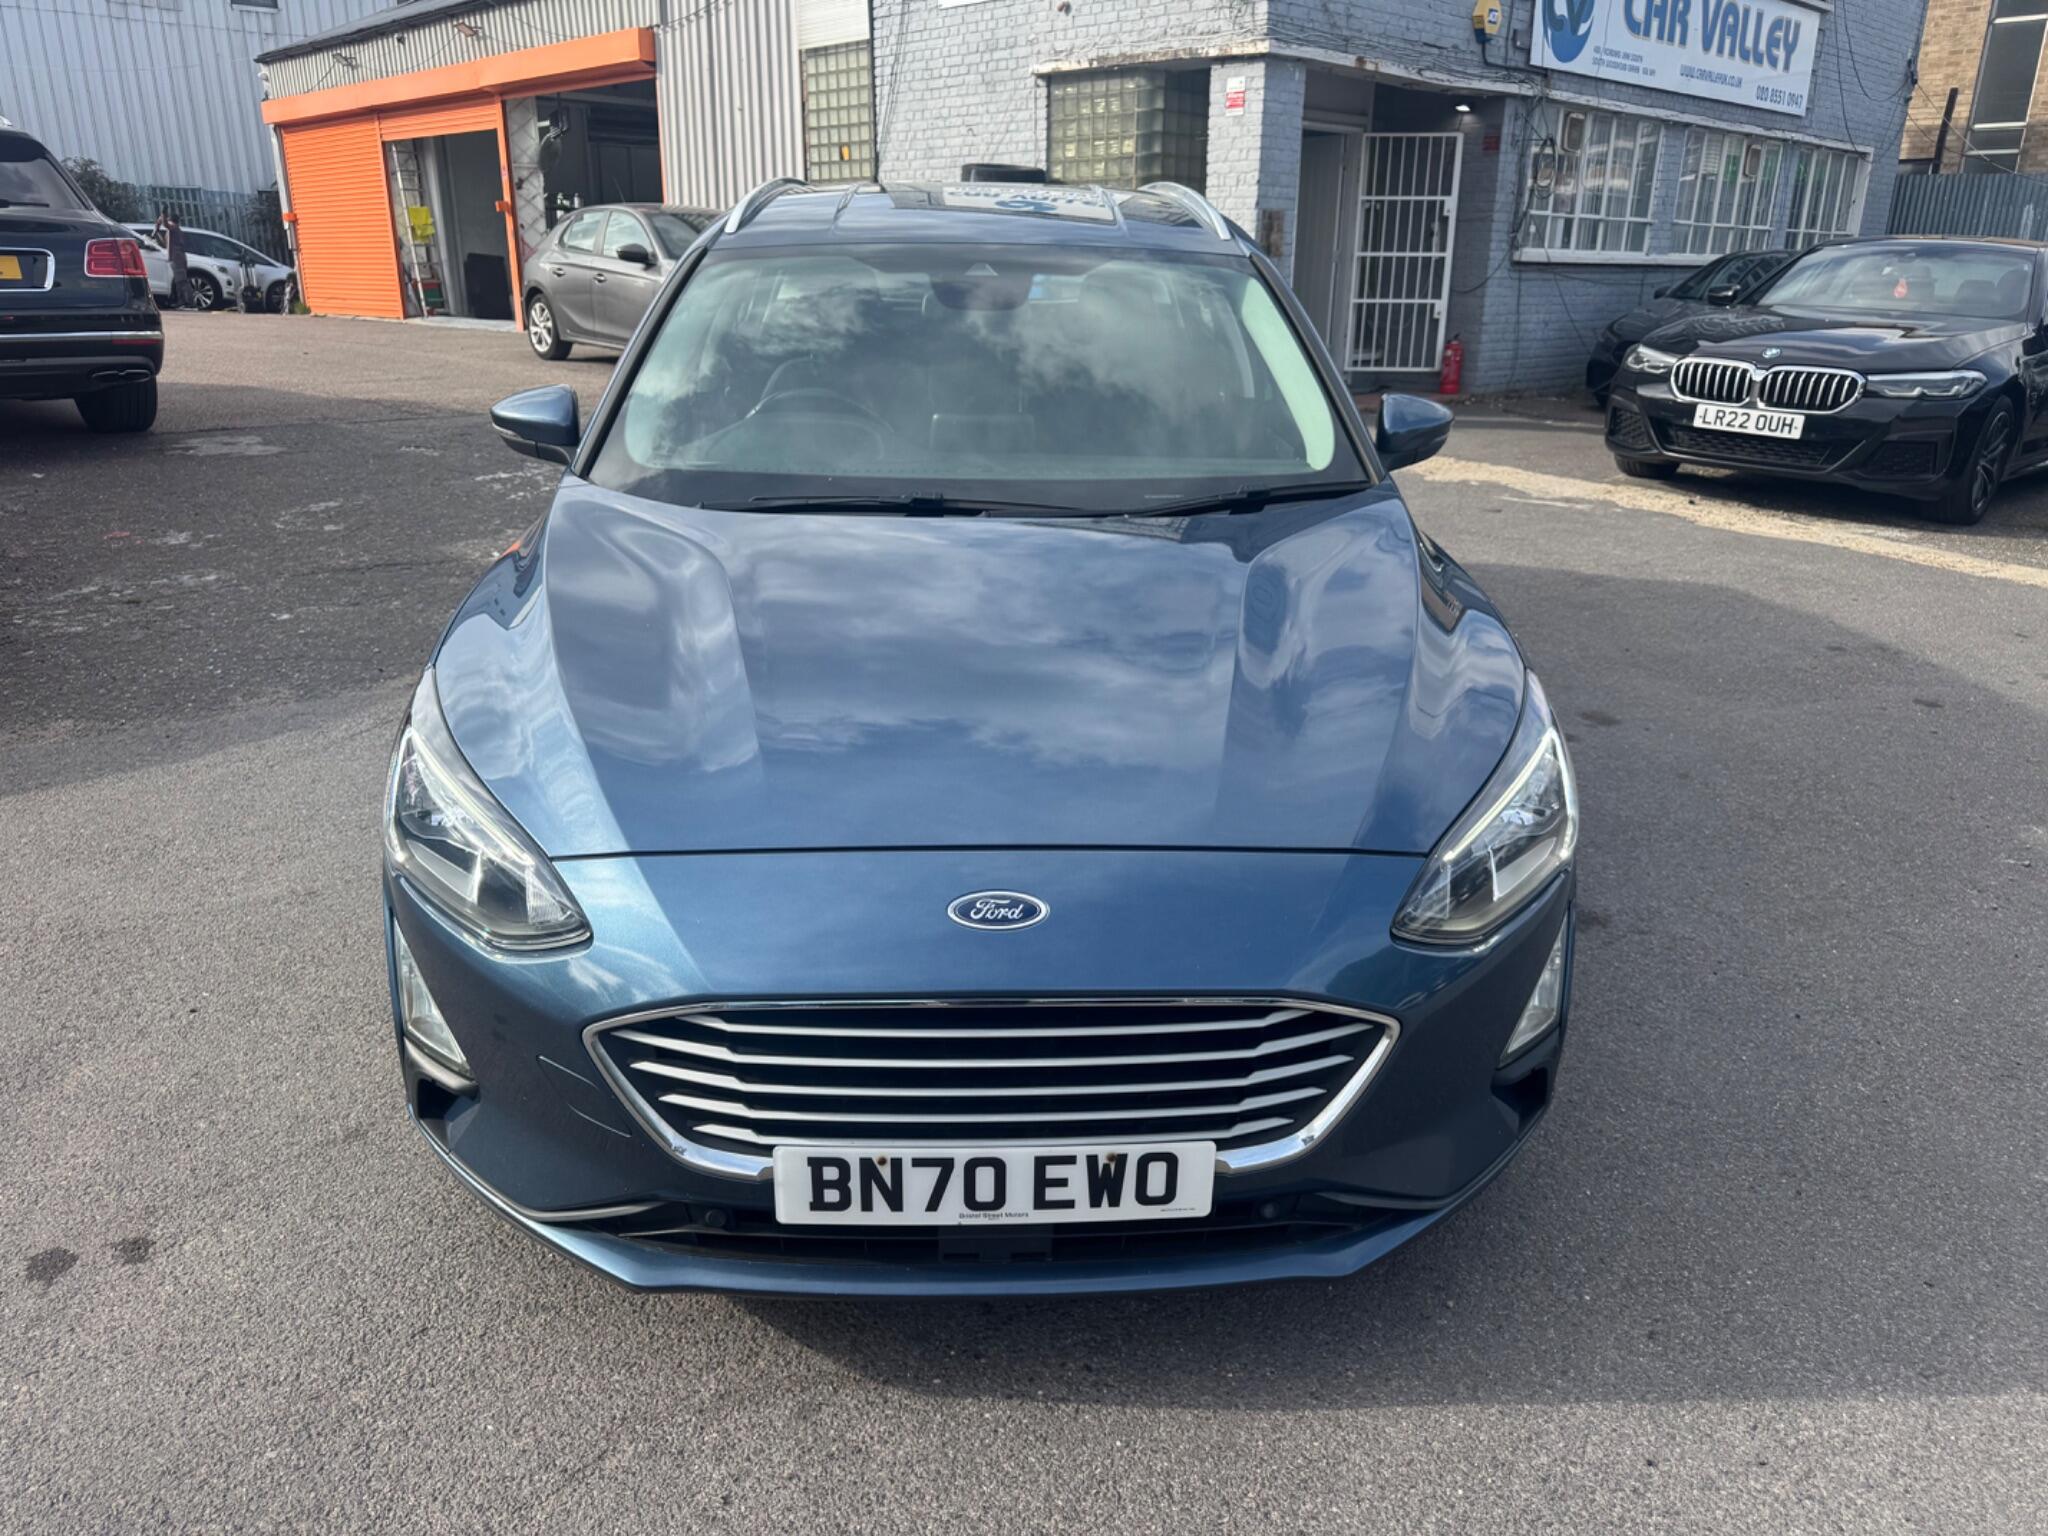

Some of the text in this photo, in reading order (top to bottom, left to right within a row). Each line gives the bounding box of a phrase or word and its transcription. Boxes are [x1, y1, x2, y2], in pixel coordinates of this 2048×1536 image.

[1623, 0, 1801, 73] CAR VALLEY
[1702, 408, 1750, 429] LR22
[970, 899, 1024, 920] Ford
[807, 1152, 1179, 1213] BN70 EWO
